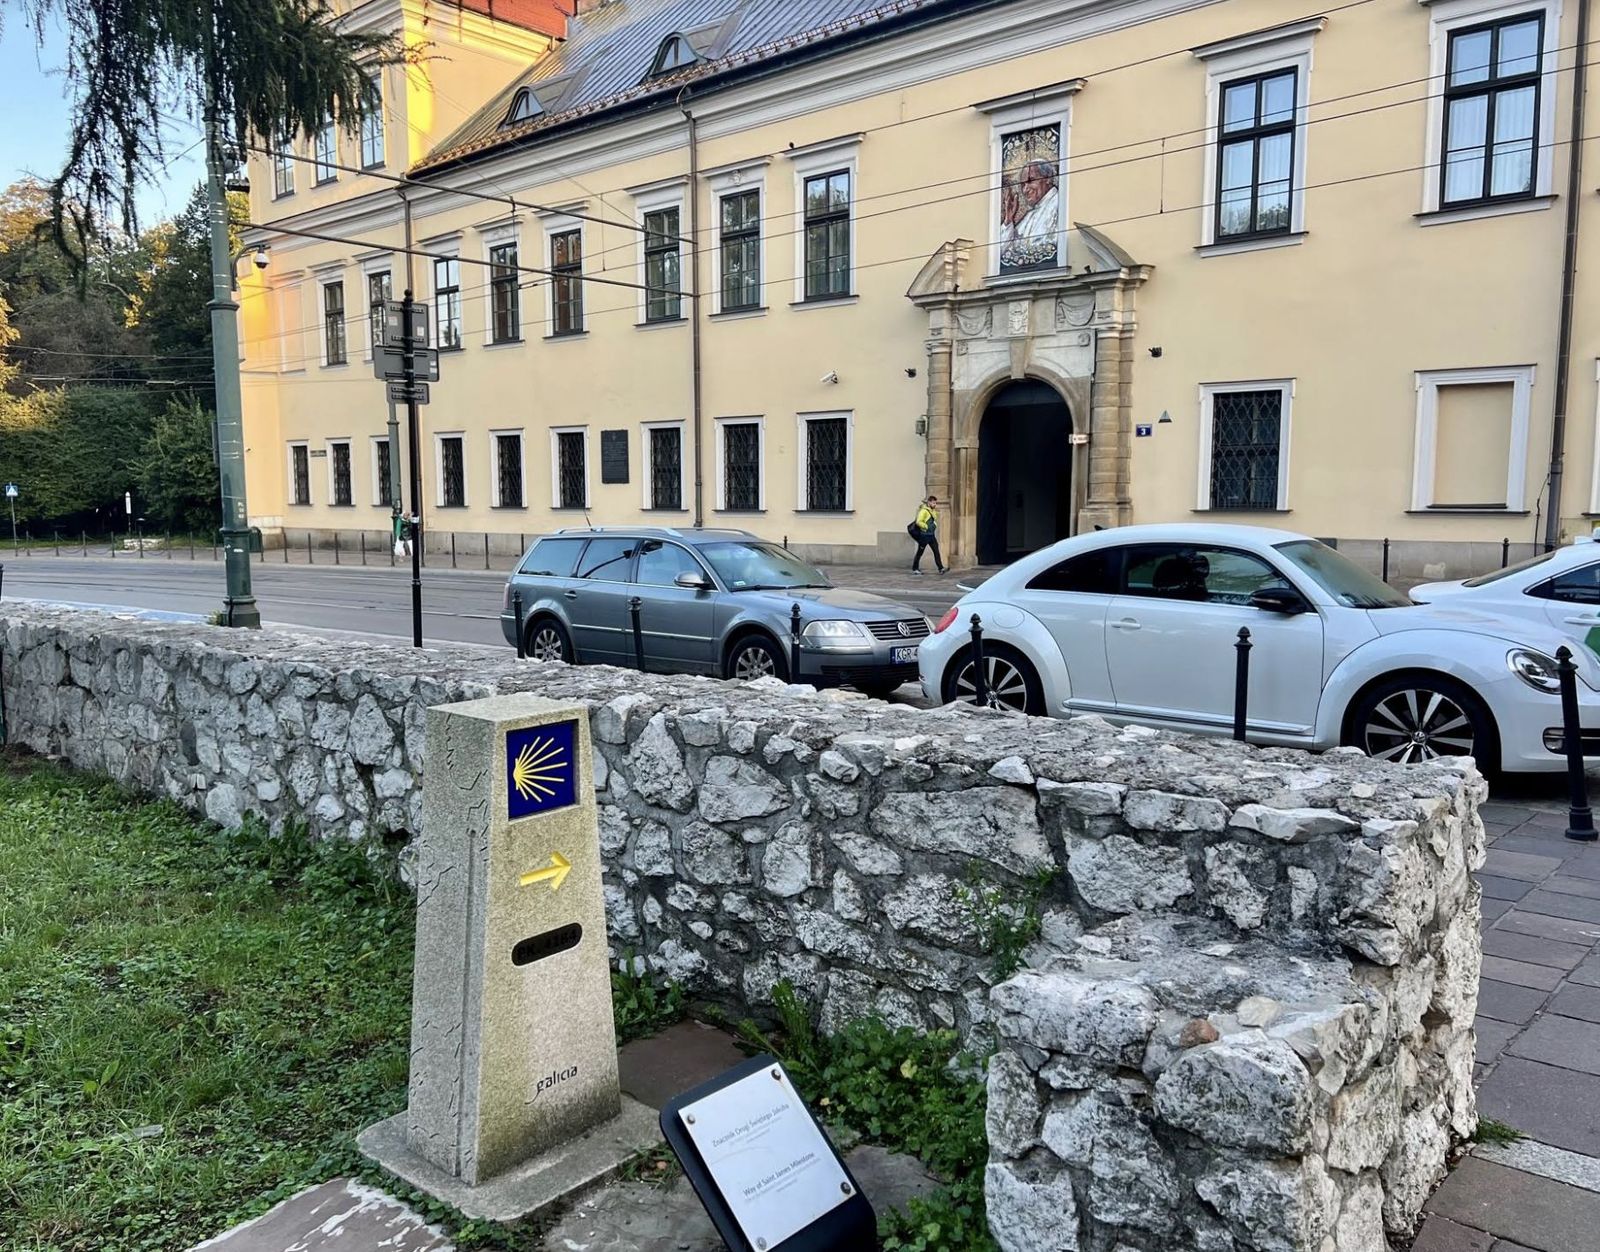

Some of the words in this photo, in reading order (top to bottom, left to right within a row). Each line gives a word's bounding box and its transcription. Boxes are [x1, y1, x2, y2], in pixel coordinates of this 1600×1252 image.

[896, 648, 912, 660] KGR
[524, 1065, 578, 1105] galicia
[743, 1184, 758, 1197] Way
[761, 1172, 777, 1186] Saint
[774, 1166, 792, 1179] James
